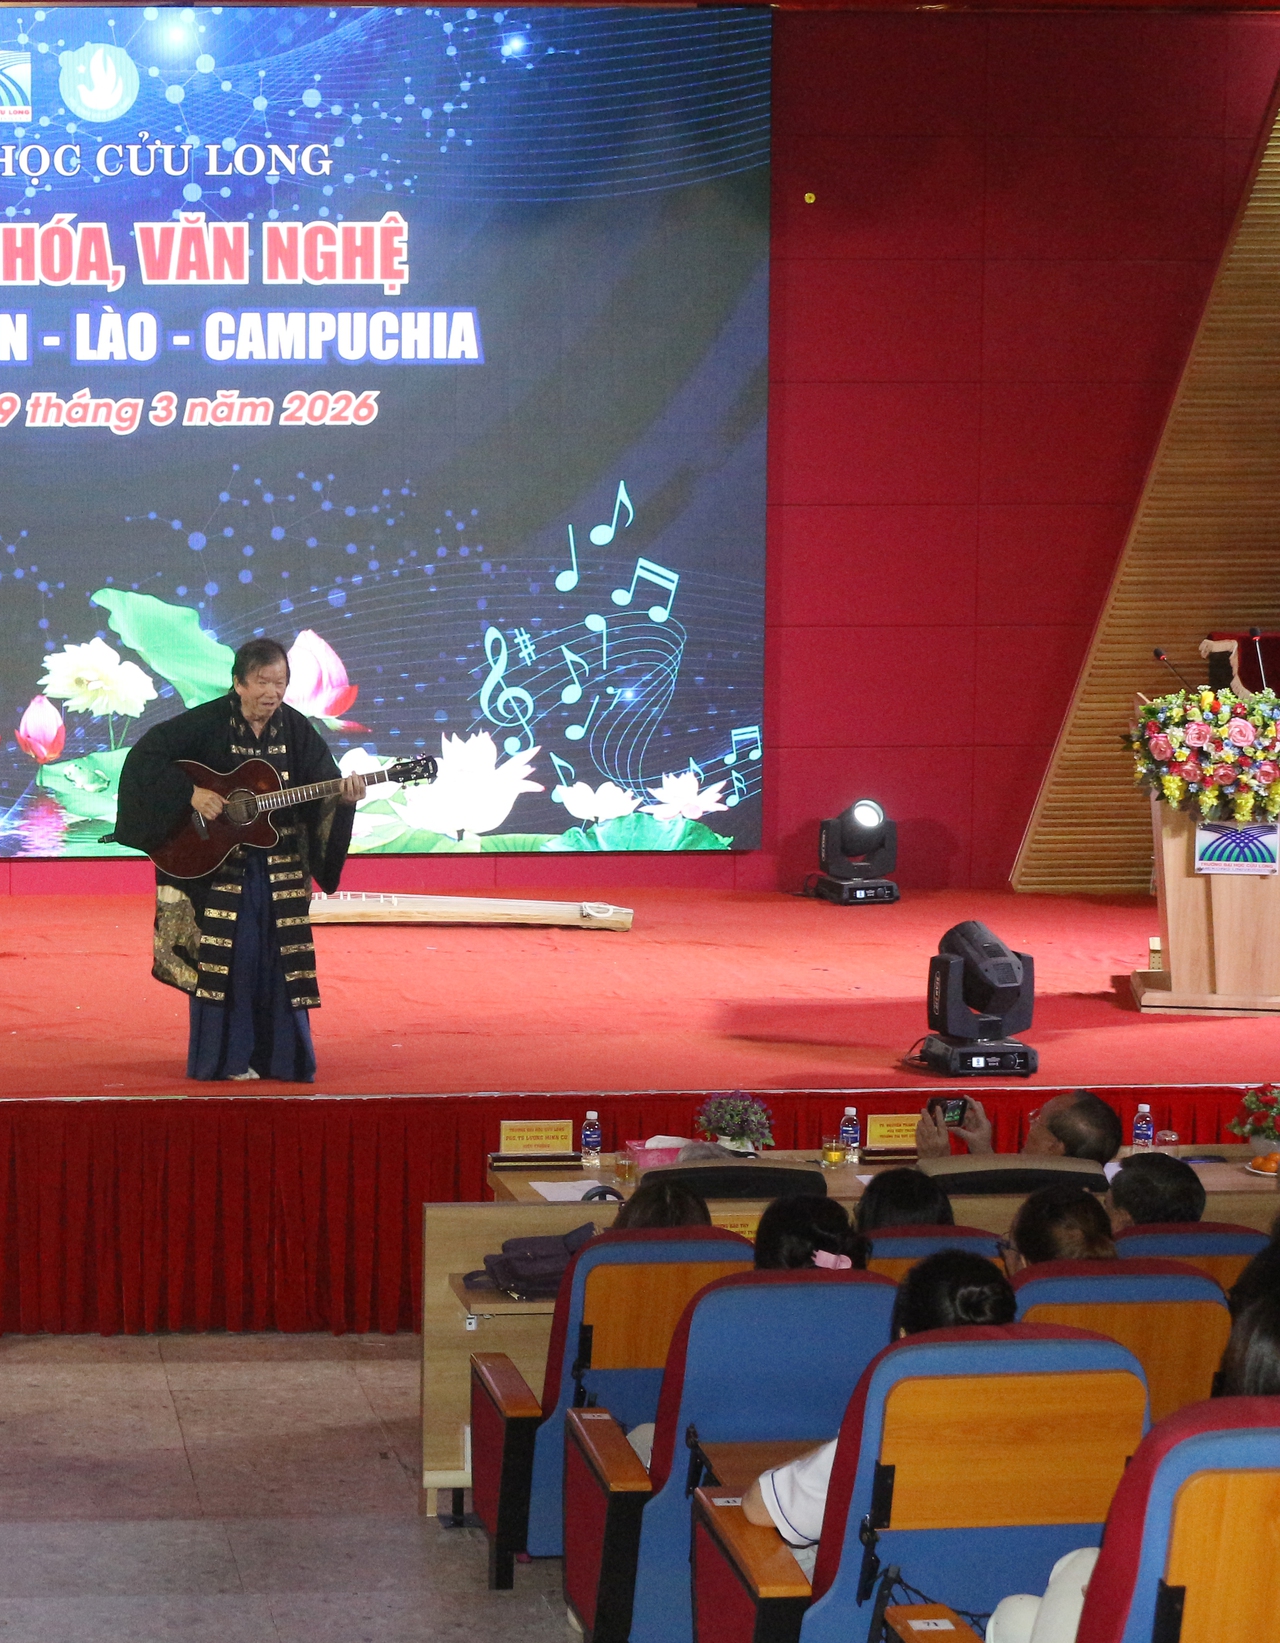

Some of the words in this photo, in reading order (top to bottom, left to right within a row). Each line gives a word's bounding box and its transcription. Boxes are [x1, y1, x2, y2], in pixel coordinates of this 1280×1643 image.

[96, 131, 192, 176] CỬU
[205, 144, 333, 176] LONG
[134, 212, 250, 284] VĂN
[262, 211, 409, 295] NGHỆ
[43, 336, 61, 347] -
[76, 306, 157, 362] LÀO
[173, 335, 190, 346] -
[205, 312, 479, 361] CAMPUCHIA
[25, 388, 140, 435] tháng
[149, 391, 177, 427] 3
[182, 390, 274, 427] năm
[279, 390, 380, 427] 2026
